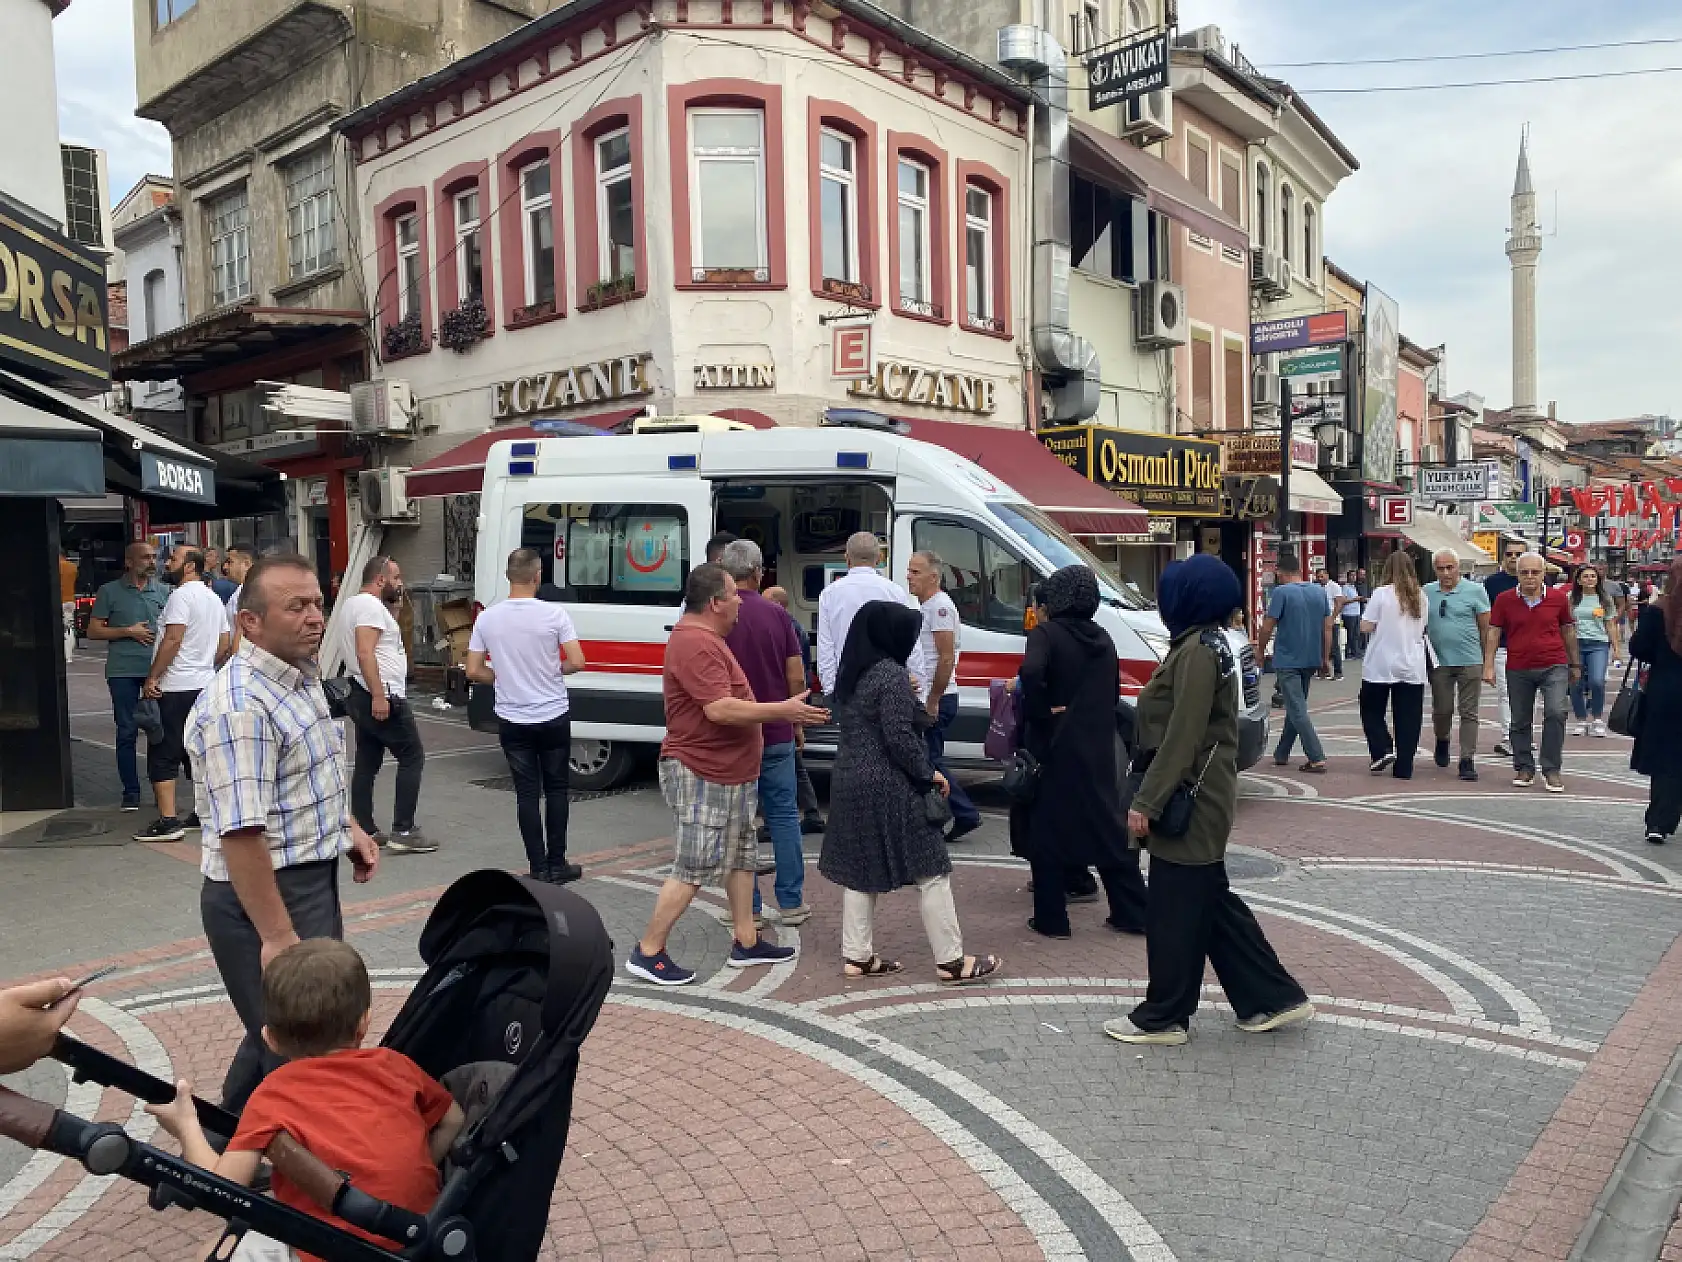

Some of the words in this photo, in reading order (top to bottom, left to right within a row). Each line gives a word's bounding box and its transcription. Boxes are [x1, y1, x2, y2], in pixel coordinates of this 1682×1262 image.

[1112, 38, 1164, 80] AVUKAT
[1254, 319, 1304, 334] ANADOLU
[841, 334, 864, 368] E
[491, 354, 652, 418] ECZANE
[696, 363, 774, 388] ALTIN
[156, 459, 203, 495] BORSA
[1100, 438, 1179, 486] Osmanlı
[1184, 448, 1221, 489] Pide
[1427, 471, 1482, 483] YURTBAY
[1389, 501, 1406, 522] E
[1256, 538, 1264, 641] ECZAN
